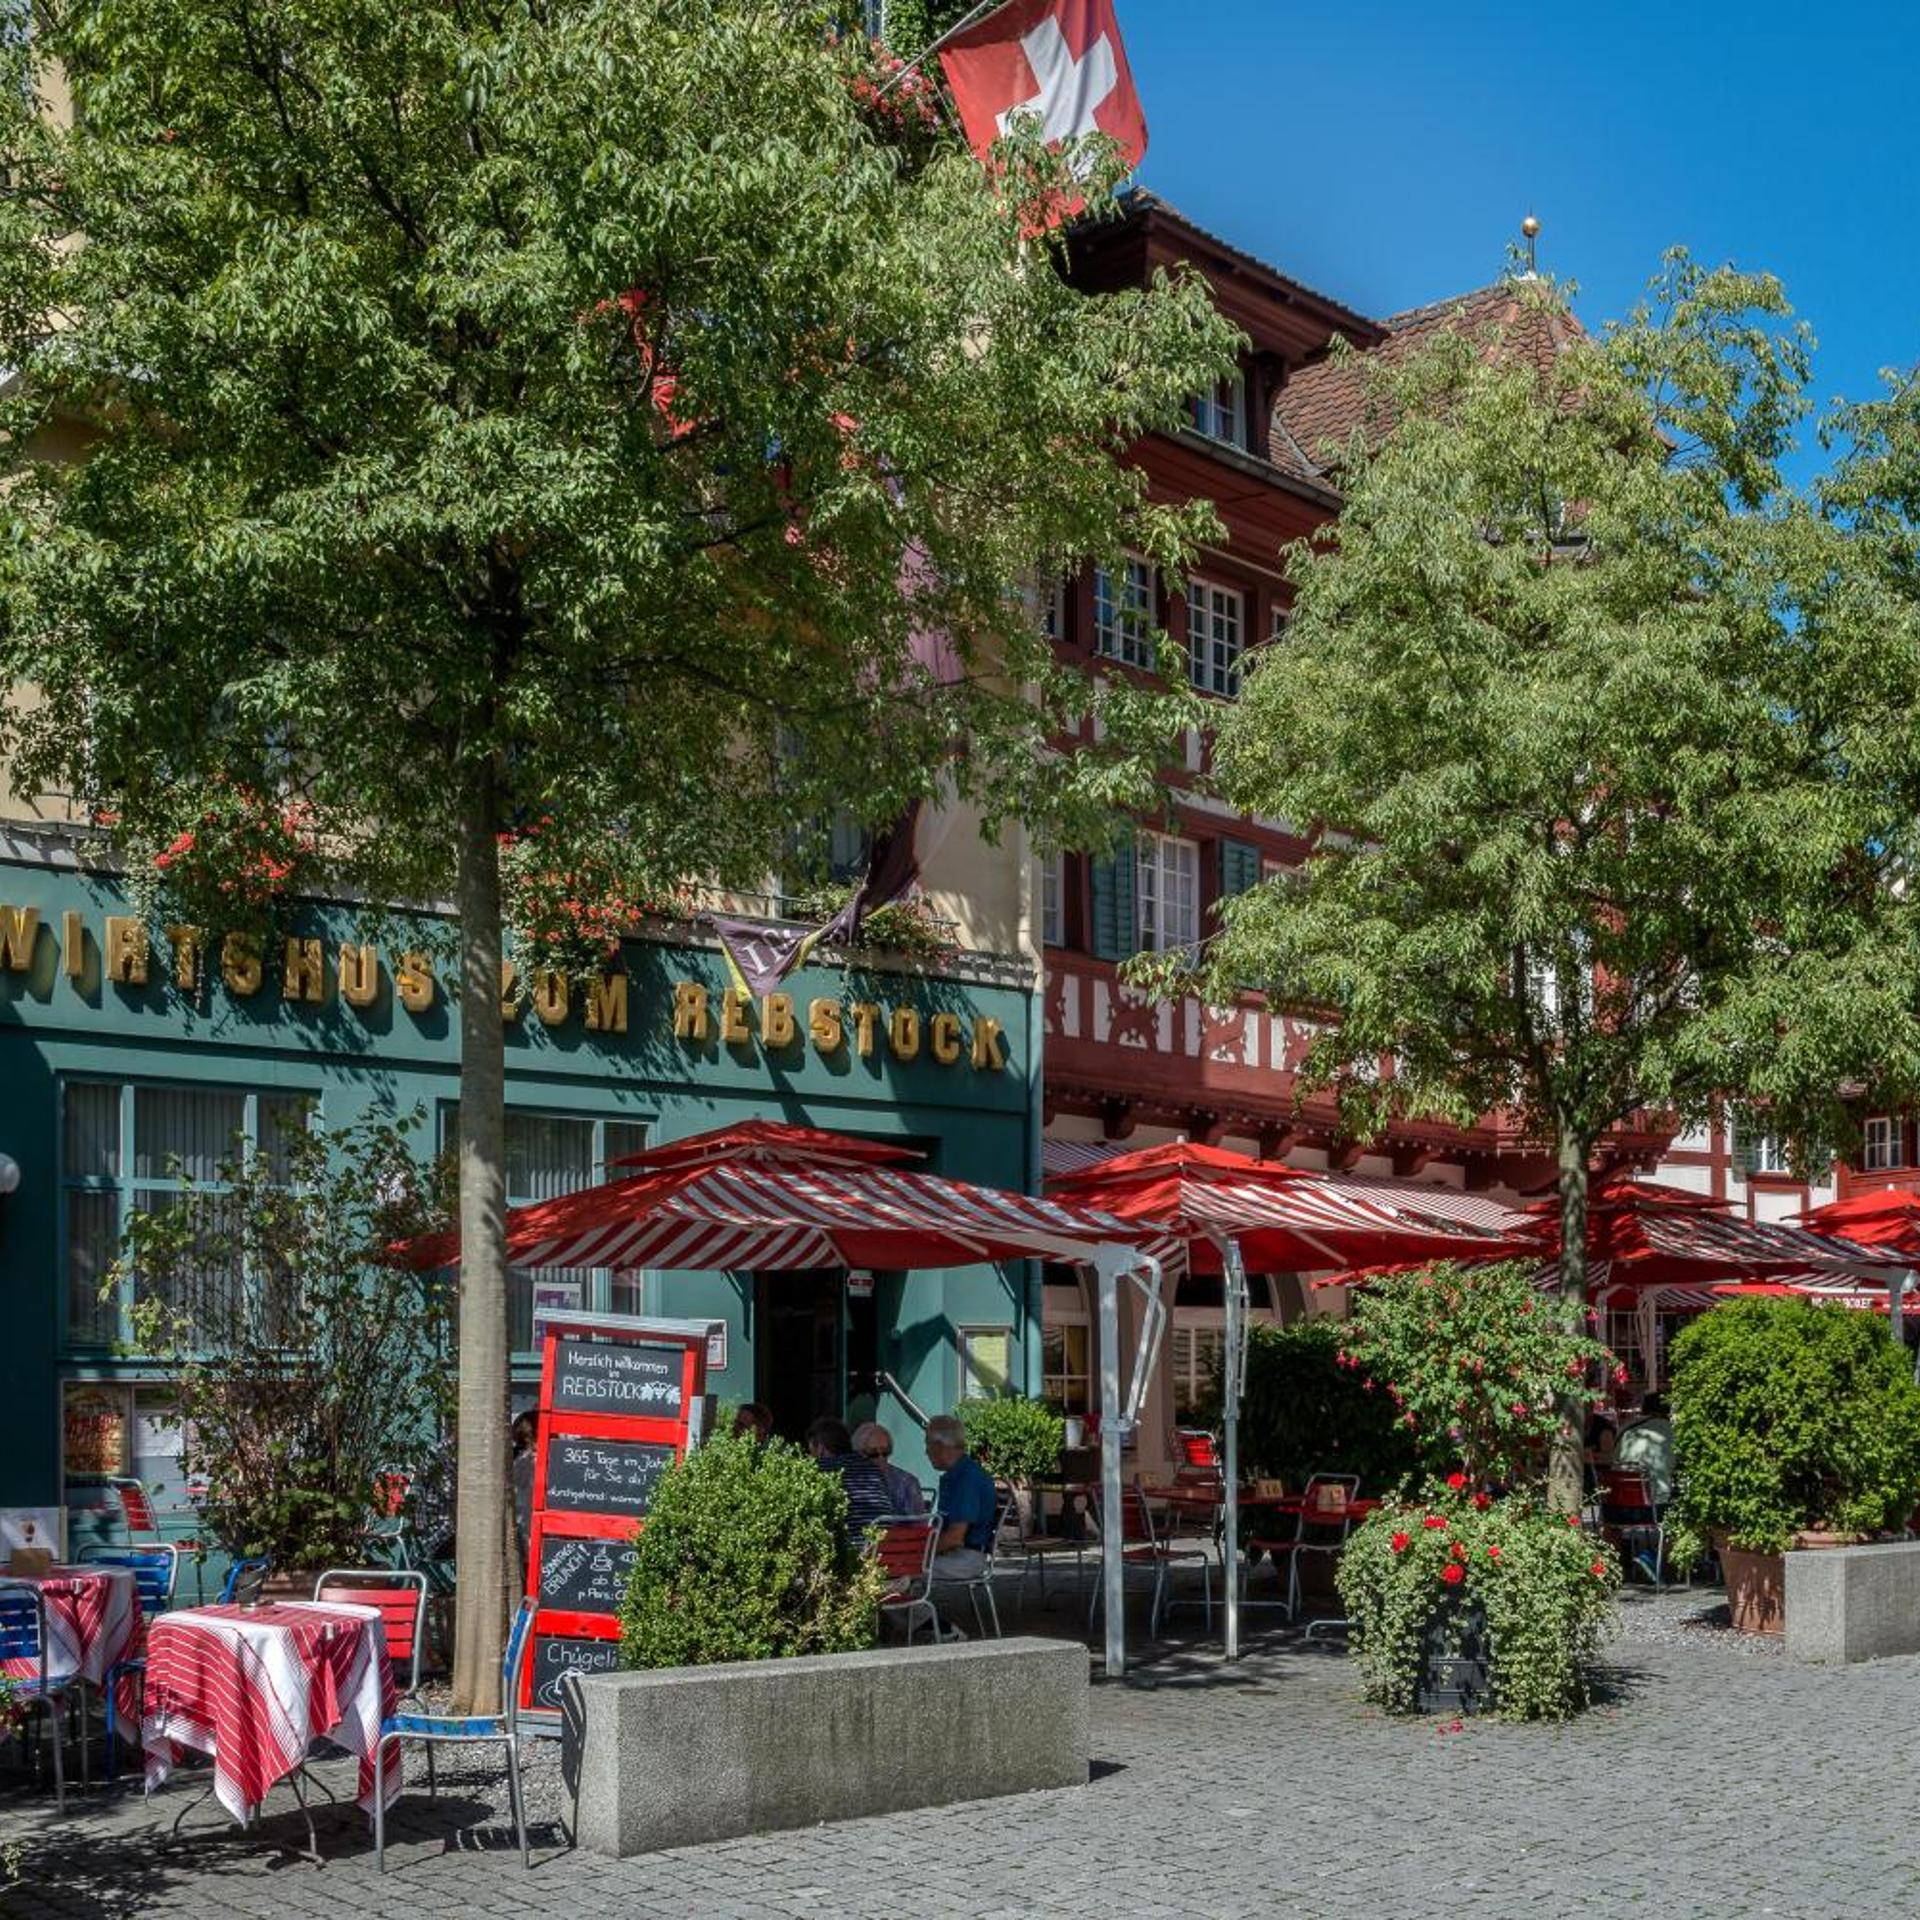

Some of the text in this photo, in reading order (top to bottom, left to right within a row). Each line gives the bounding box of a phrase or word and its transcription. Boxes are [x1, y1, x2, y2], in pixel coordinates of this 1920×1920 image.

[675, 981, 1005, 1071] REBSTOCK
[562, 1376, 641, 1400] REBSTOCK
[563, 1447, 590, 1464] 365
[594, 1450, 620, 1470] Tage
